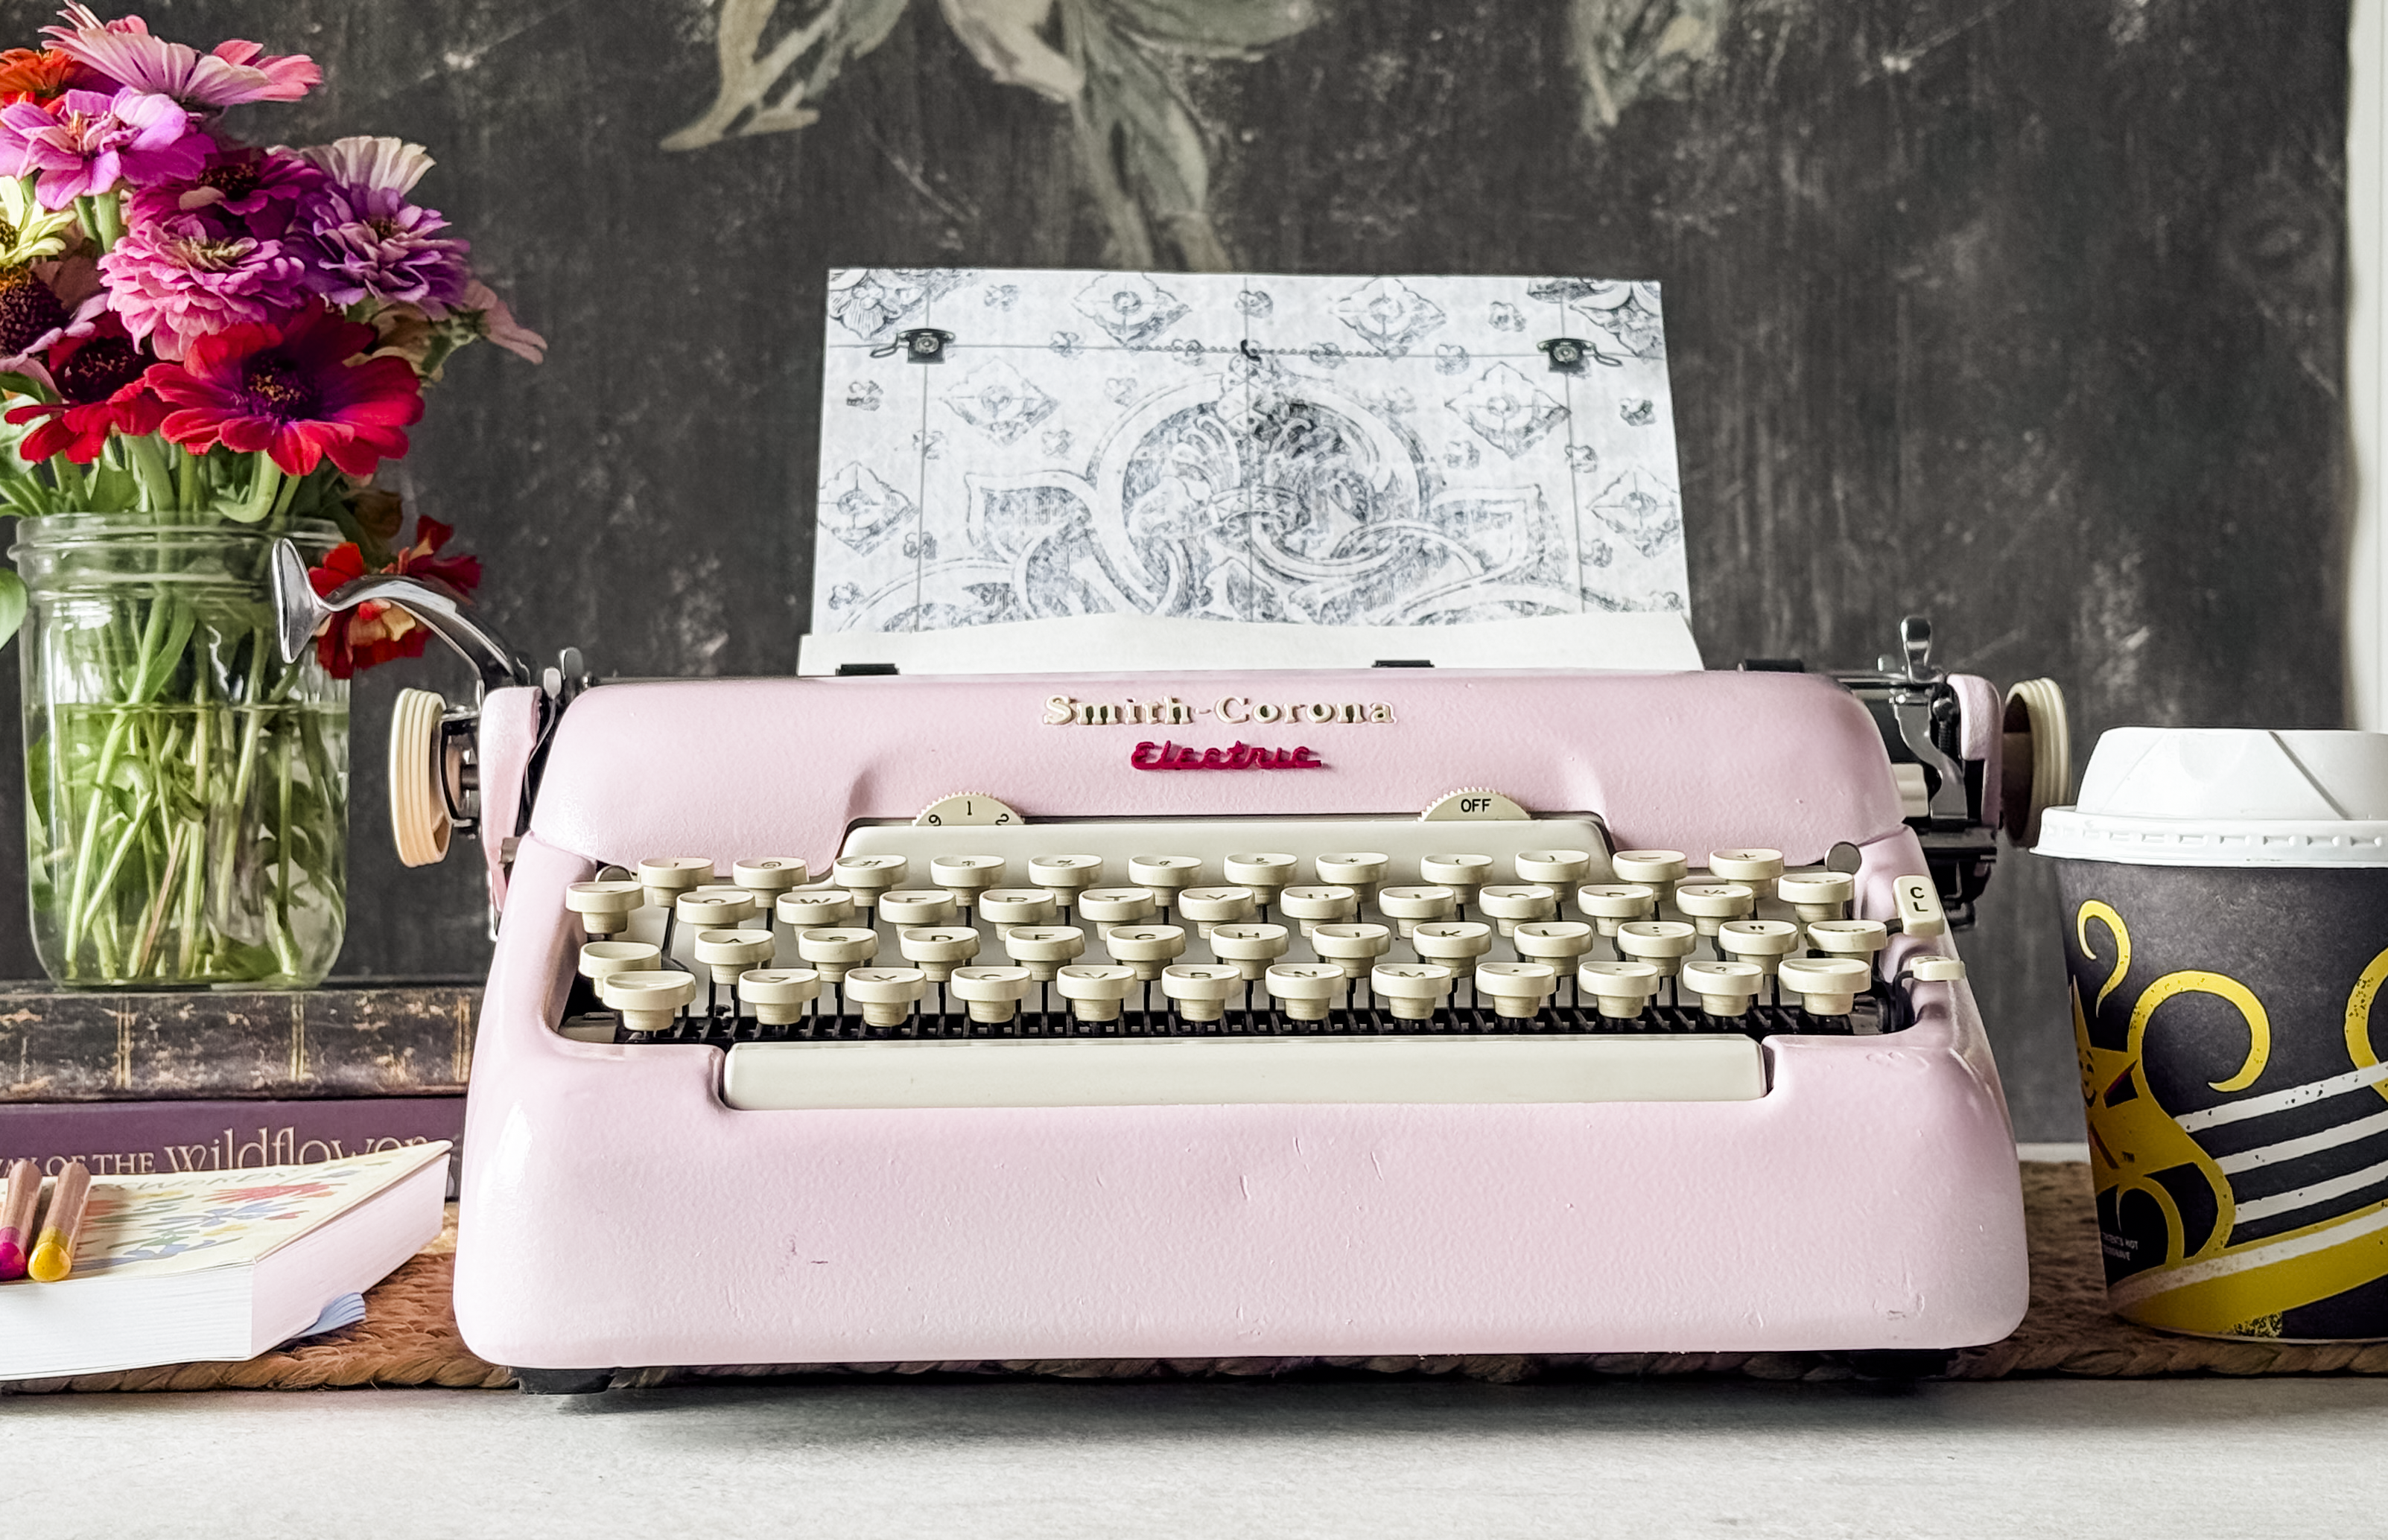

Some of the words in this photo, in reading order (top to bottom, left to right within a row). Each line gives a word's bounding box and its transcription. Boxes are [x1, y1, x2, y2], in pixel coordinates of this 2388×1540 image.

[1043, 695, 1397, 725] Smith-Corona
[1131, 740, 1322, 771] Electric
[967, 800, 973, 816] 1
[995, 813, 1010, 826] 2
[1461, 798, 1492, 813] OFF
[92, 1152, 156, 1174] THE
